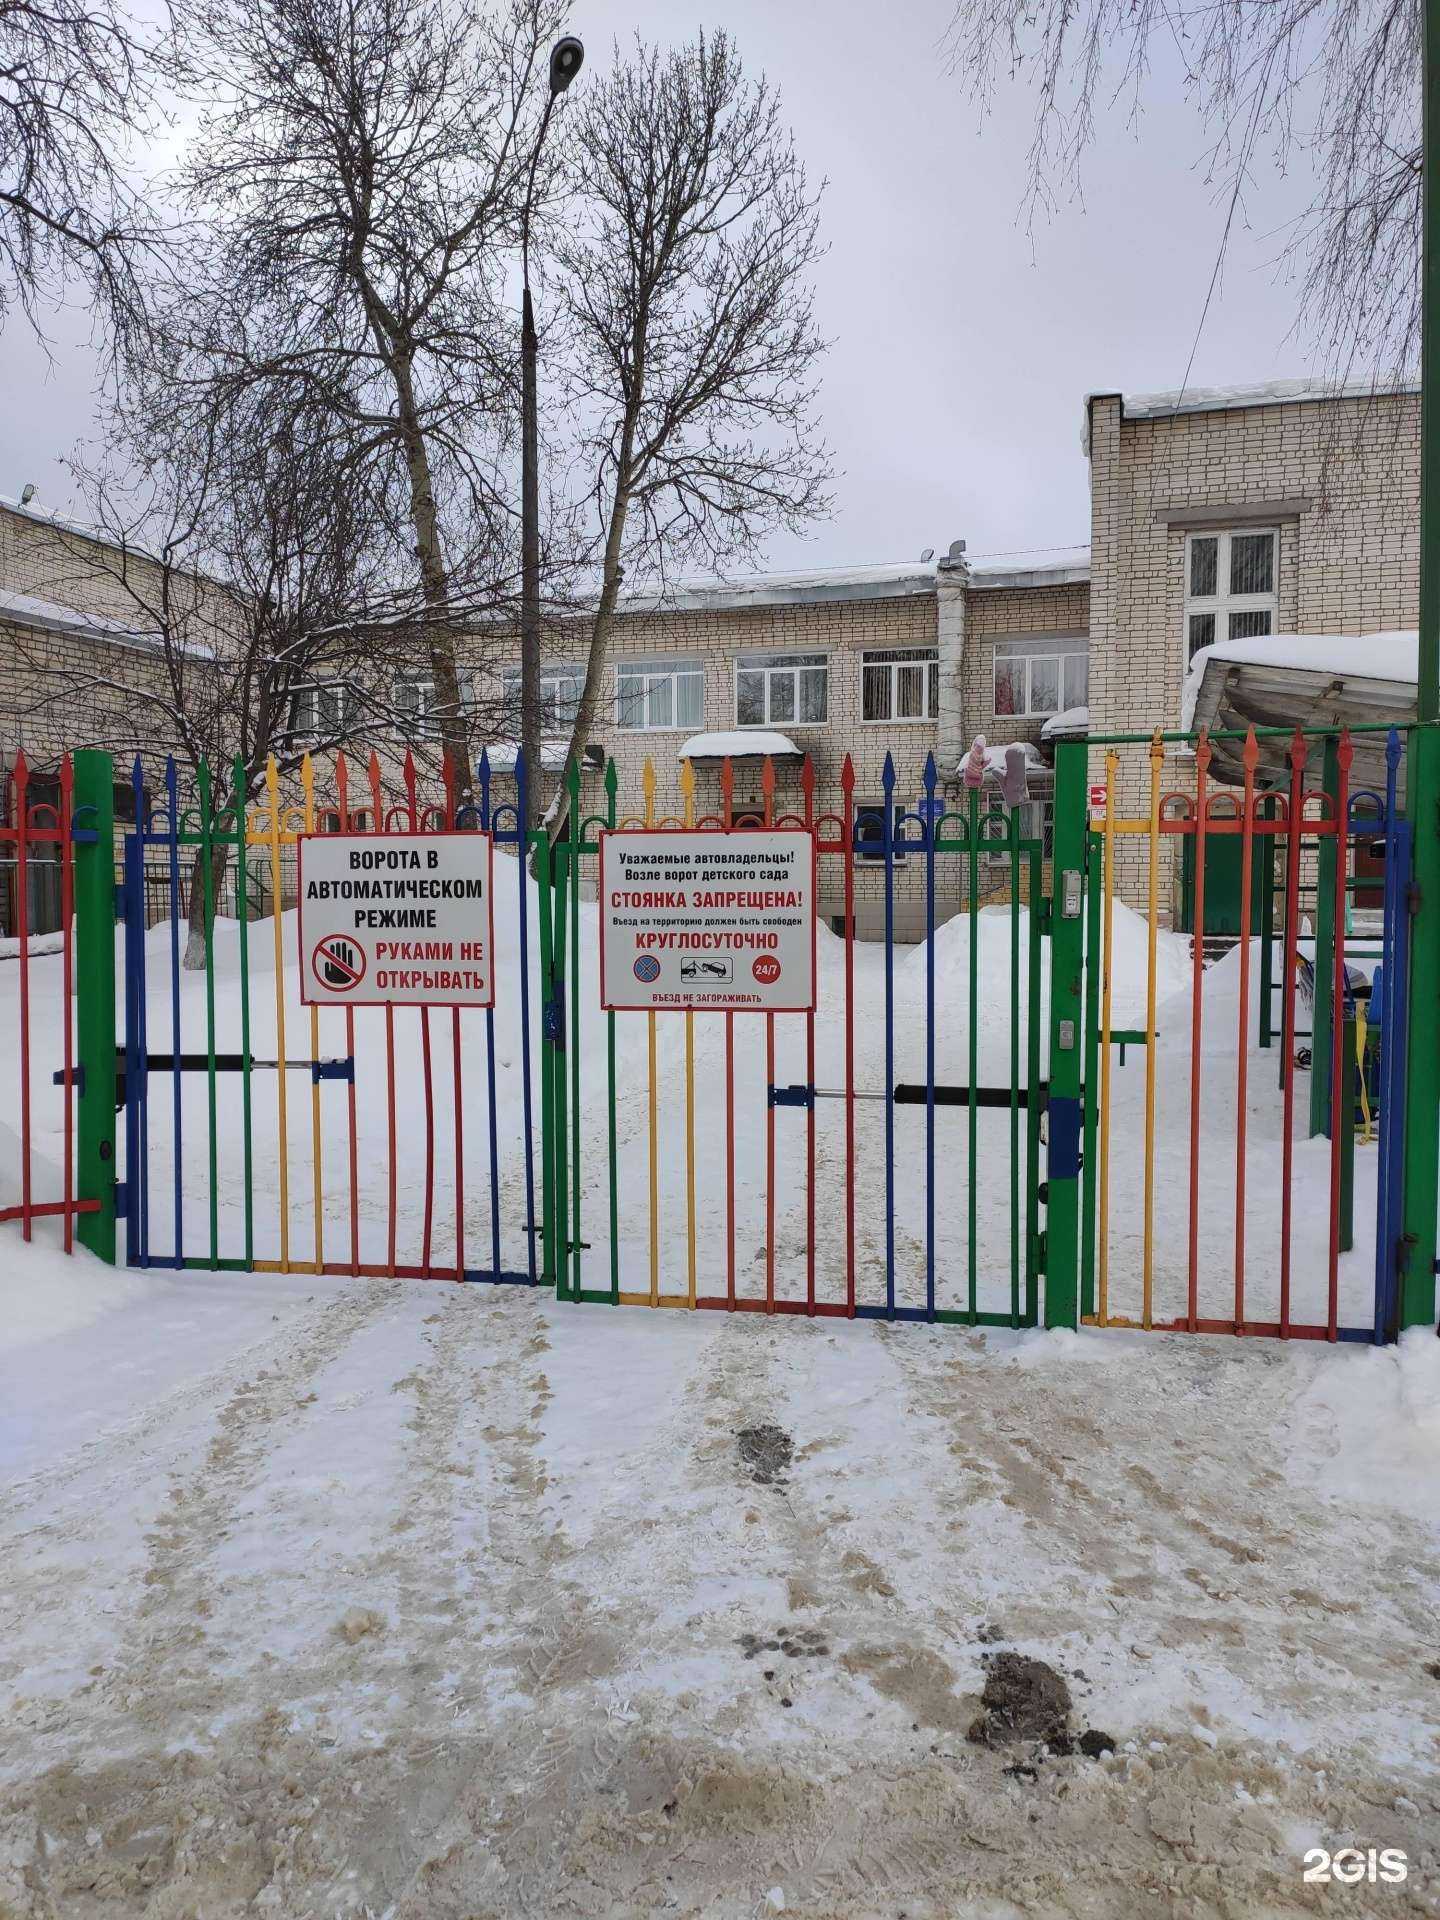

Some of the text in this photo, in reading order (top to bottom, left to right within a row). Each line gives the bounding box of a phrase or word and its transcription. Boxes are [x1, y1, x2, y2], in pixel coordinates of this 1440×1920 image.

[349, 851, 438, 869] ВОРОТА В
[619, 852, 794, 865] Уважаемые автовладельцы!
[625, 869, 789, 882] Возле ворот детского сада
[307, 879, 482, 899] АВТОМАТИЧЕСКОМ
[612, 892, 802, 910] СТОЯНКА ЗАПРЕЩЕНА!
[355, 909, 436, 928] РЕЖИМЕ
[613, 918, 637, 926] Въезд
[763, 918, 802, 926] свободен
[636, 933, 778, 949] КРУГЛОСУТОЧНО
[376, 943, 483, 960] РУКАМИ НЕ
[755, 965, 777, 975] 24/7
[376, 971, 484, 989] ОТКРЫВАТЬ
[652, 994, 762, 1002] ВЪЕЗД НЕ ЗАГОРАЖИВАТЬ
